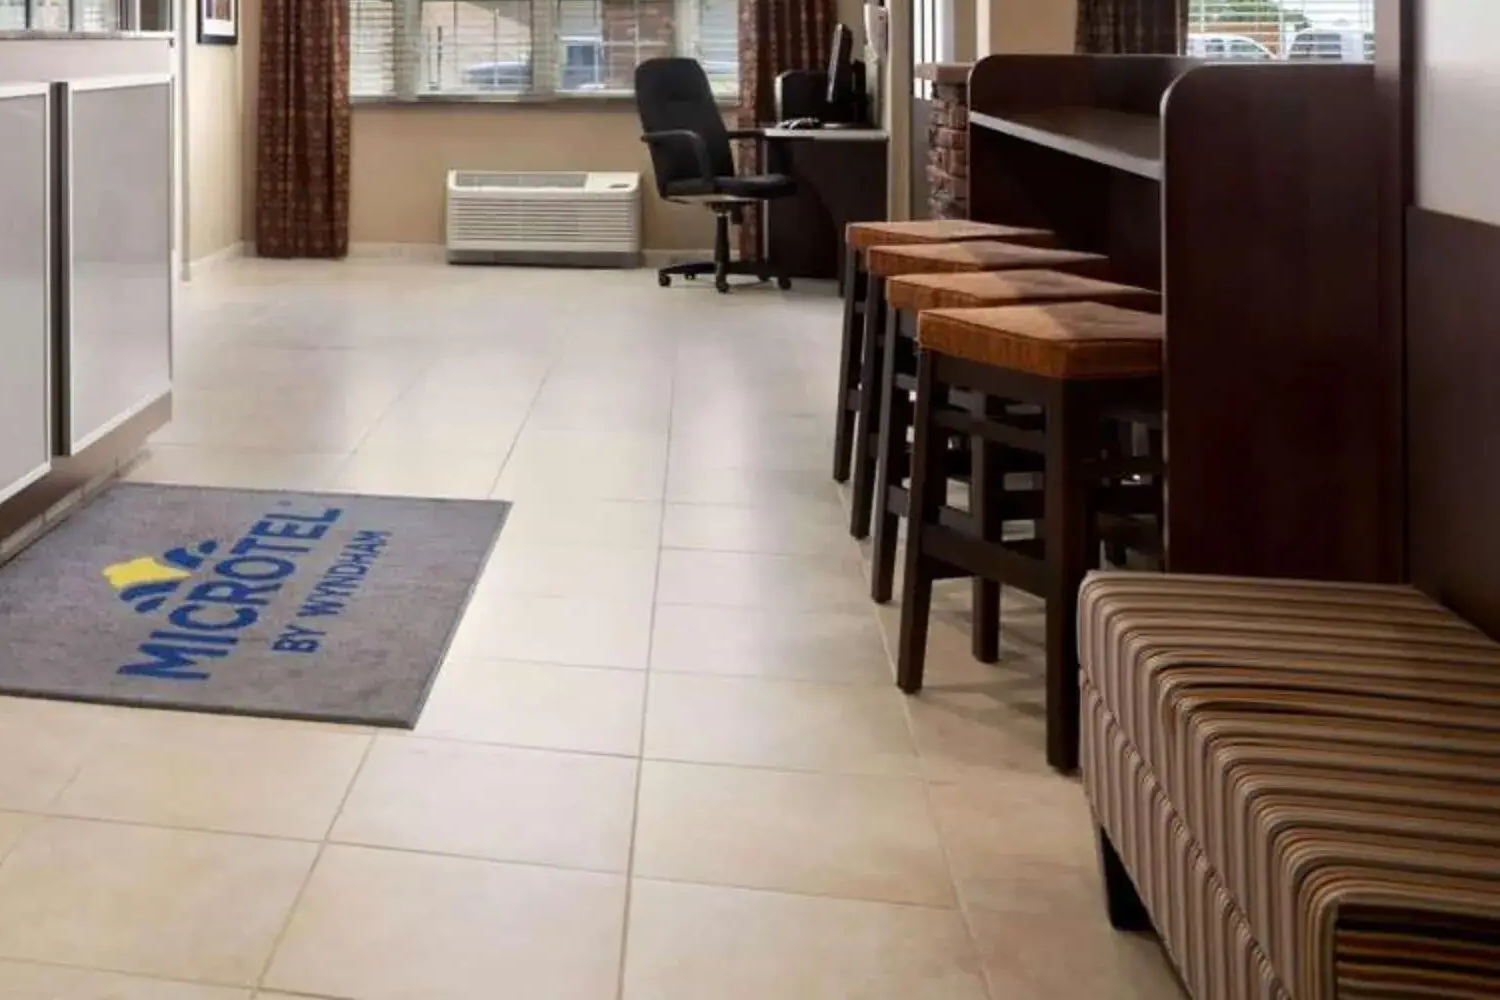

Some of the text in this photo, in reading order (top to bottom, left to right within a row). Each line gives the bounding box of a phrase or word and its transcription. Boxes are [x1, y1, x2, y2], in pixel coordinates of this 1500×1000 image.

[116, 507, 343, 681] MICROTEL
[271, 529, 391, 654] BY WYNDHAM
